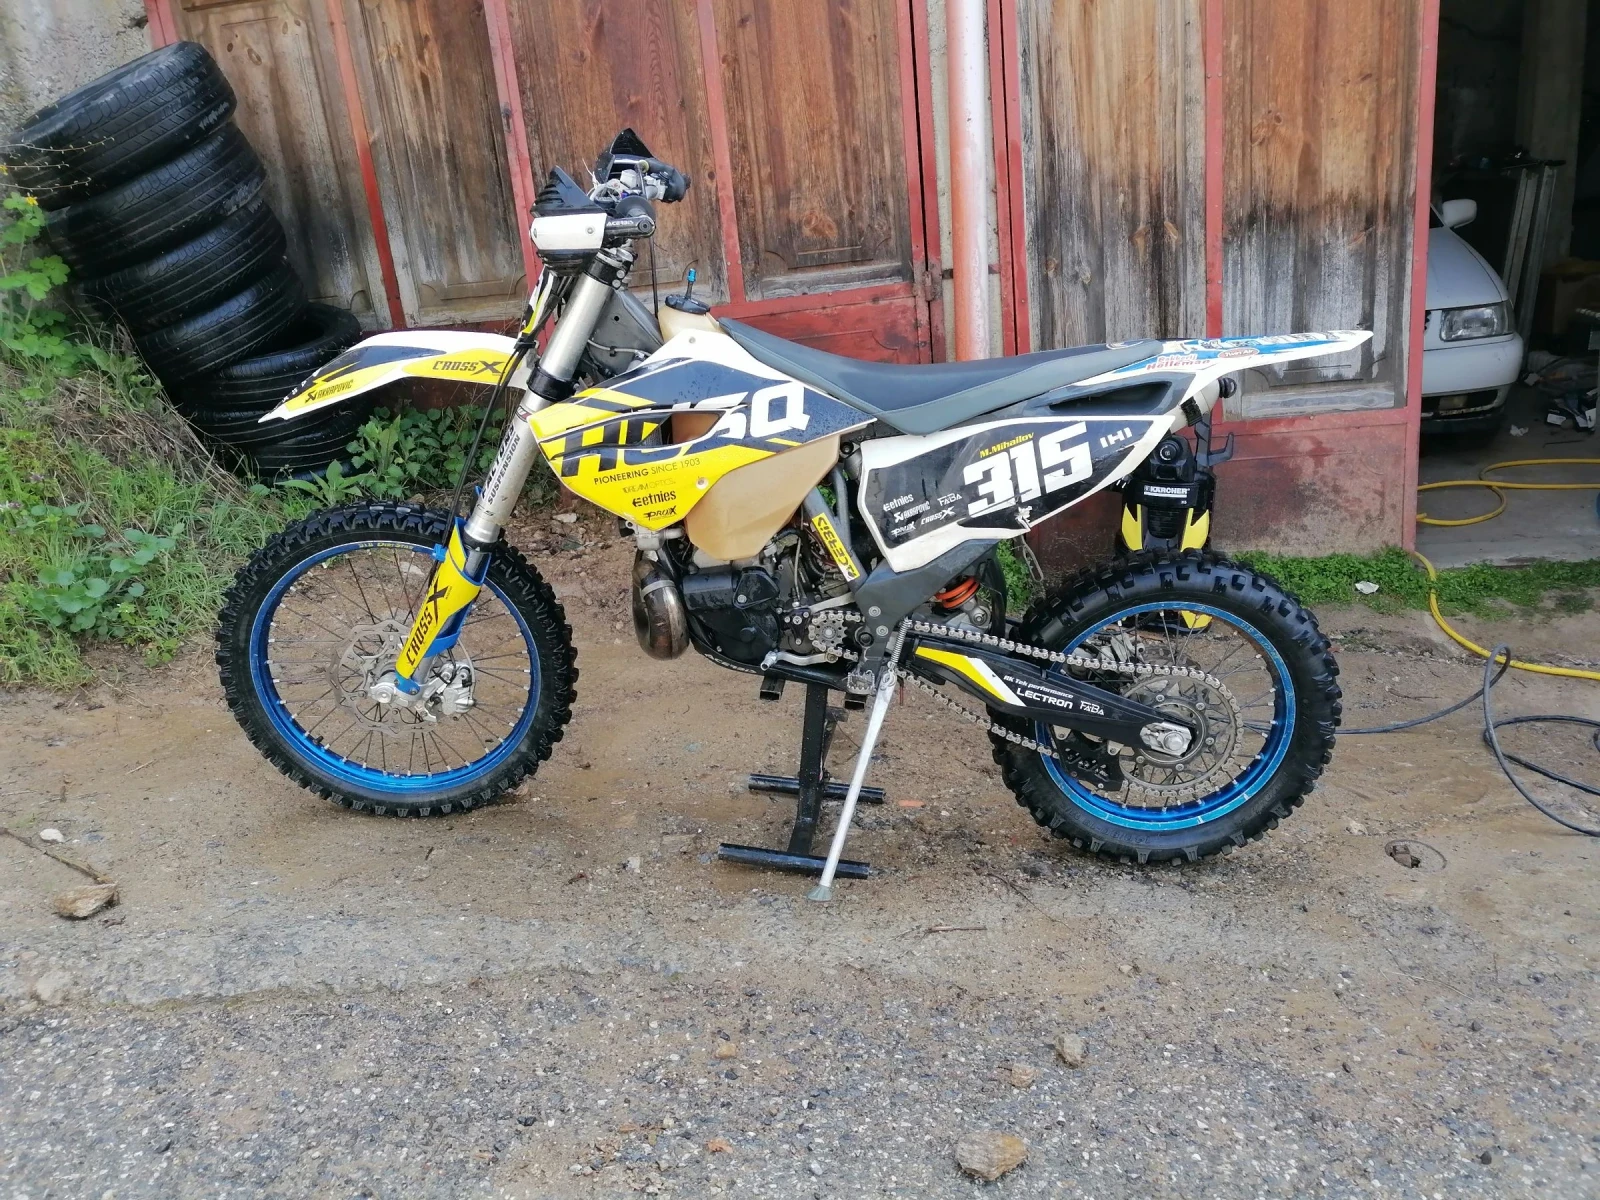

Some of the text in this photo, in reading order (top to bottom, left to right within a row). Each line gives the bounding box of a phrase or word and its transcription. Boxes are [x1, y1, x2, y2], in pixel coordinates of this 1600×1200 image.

[487, 434, 521, 505] SUSPENSION
[594, 457, 701, 485] PIONEERING SINCE 1903
[963, 421, 1093, 518] 315
[1016, 687, 1073, 709] LECTRON
